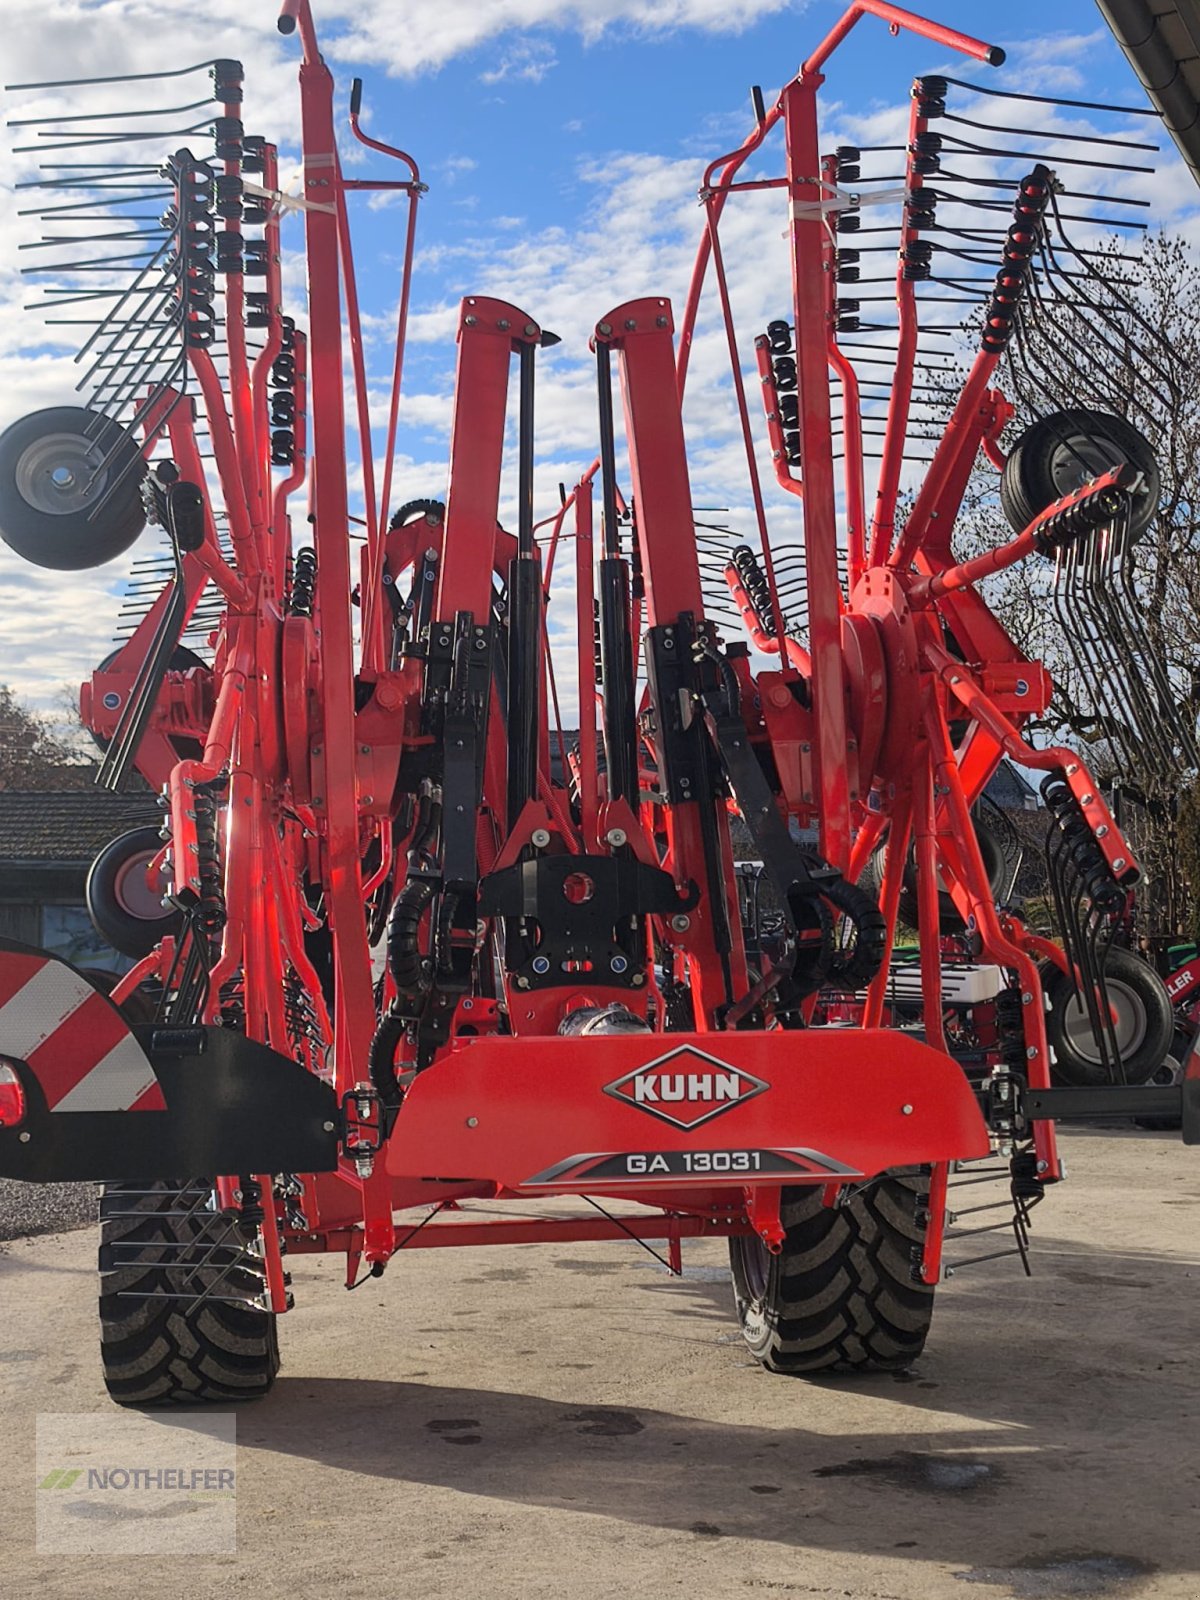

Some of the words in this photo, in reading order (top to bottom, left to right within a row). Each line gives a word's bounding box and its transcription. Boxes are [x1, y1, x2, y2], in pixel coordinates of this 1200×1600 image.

[1167, 970, 1194, 997] LER
[634, 1073, 740, 1101] KUHN
[626, 1154, 670, 1173] GA
[682, 1152, 761, 1172] 13031
